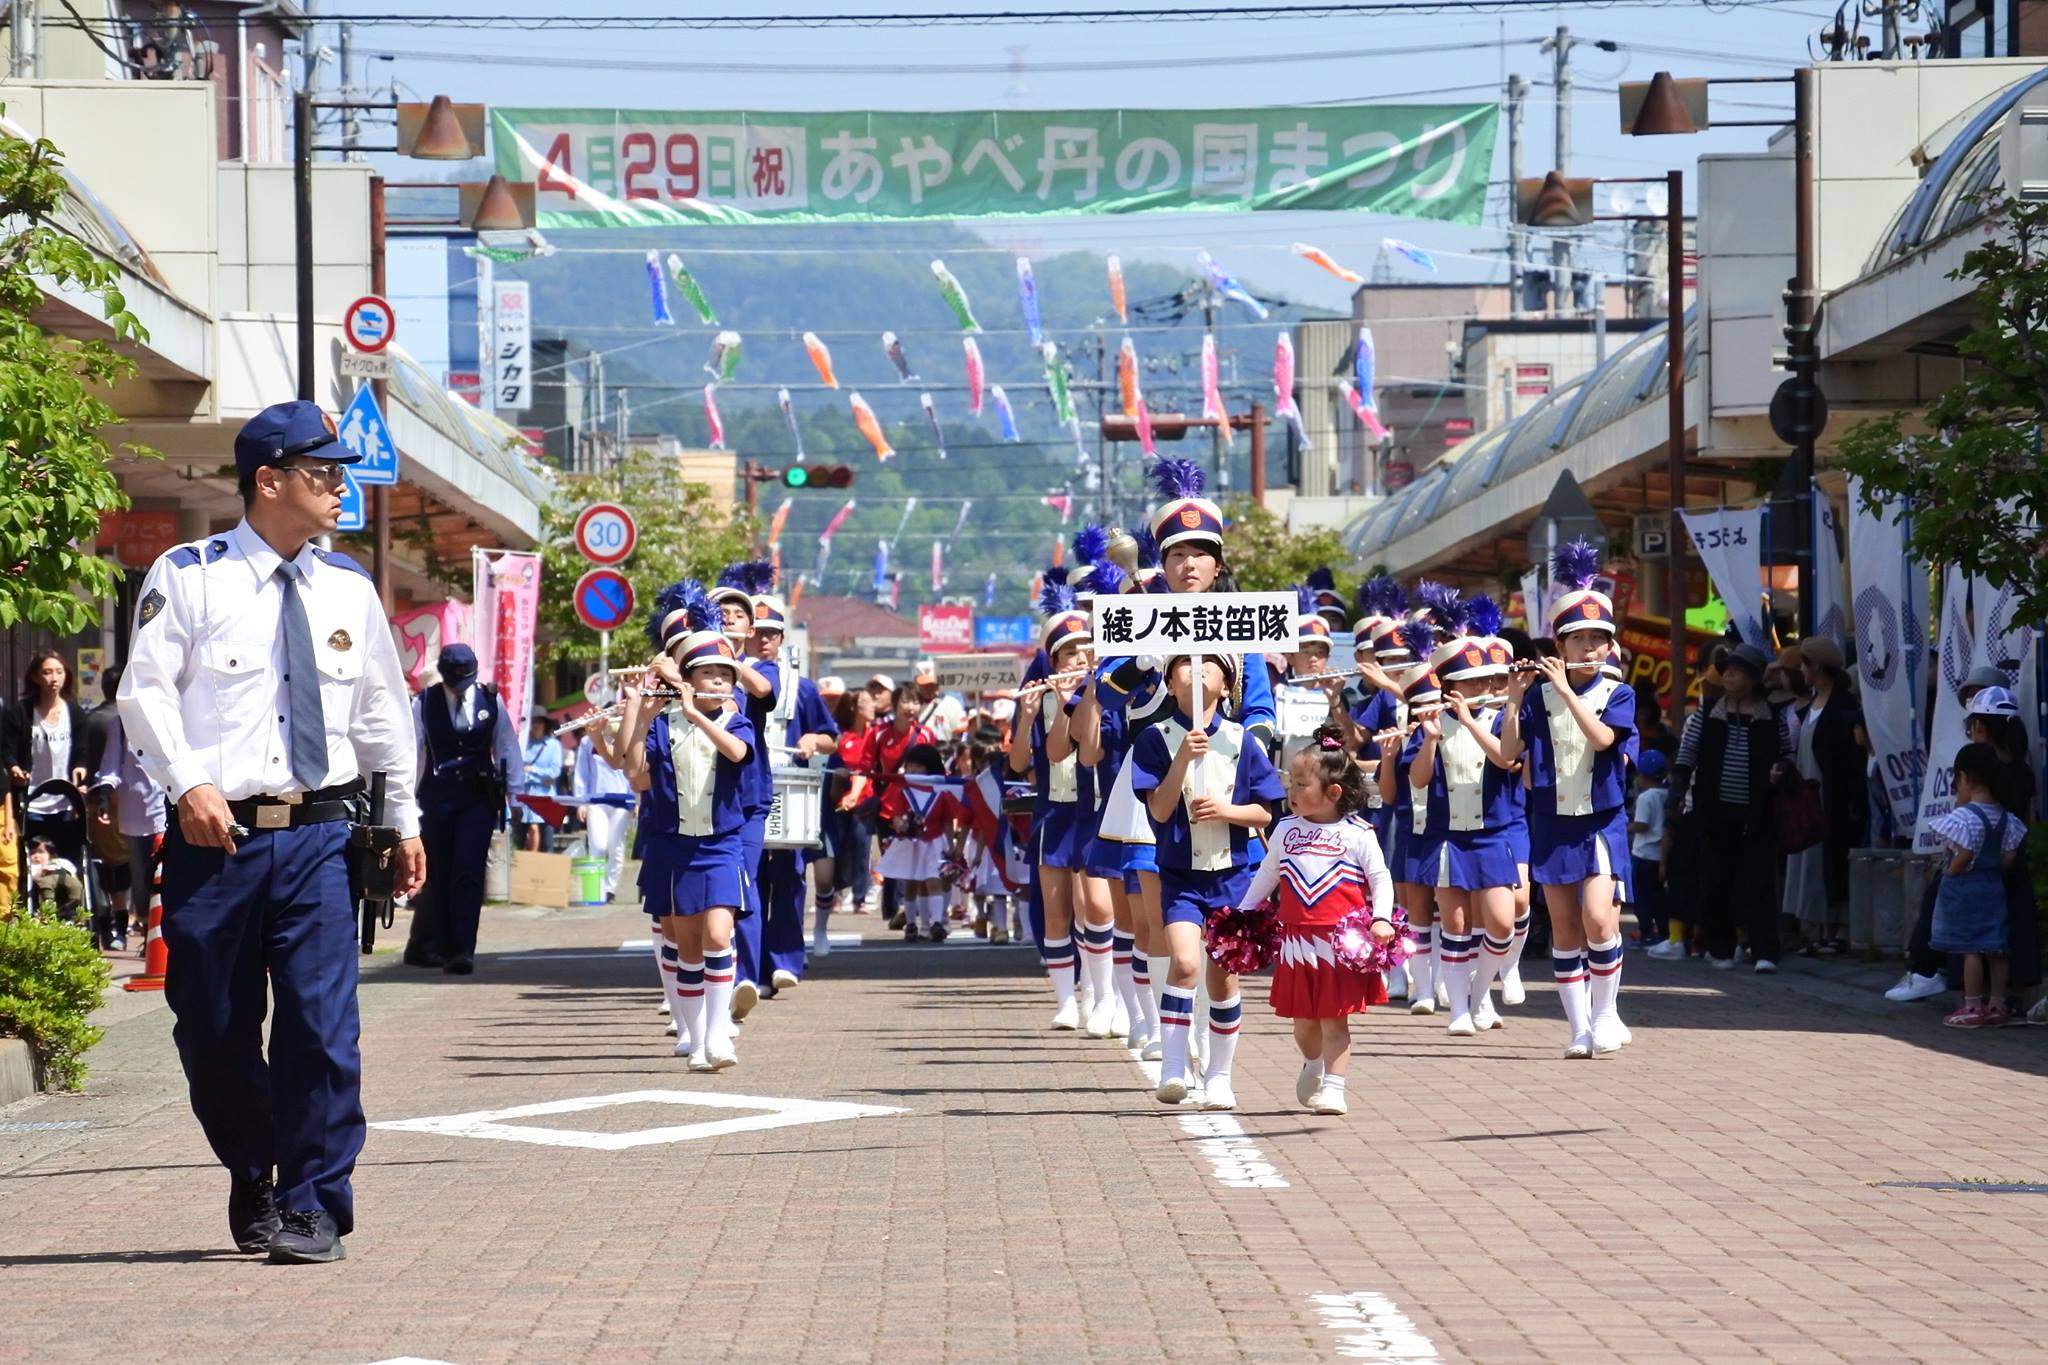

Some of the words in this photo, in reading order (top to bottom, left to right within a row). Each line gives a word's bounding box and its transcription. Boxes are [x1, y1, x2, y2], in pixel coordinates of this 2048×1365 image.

[819, 121, 1469, 204] あやべ丹の国まつり
[499, 342, 524, 403] シカタ
[589, 521, 622, 548] 30
[1644, 533, 1664, 551] P
[1102, 604, 1290, 644] 綾ノ本鼓笛隊
[769, 792, 782, 837] YAMAHA
